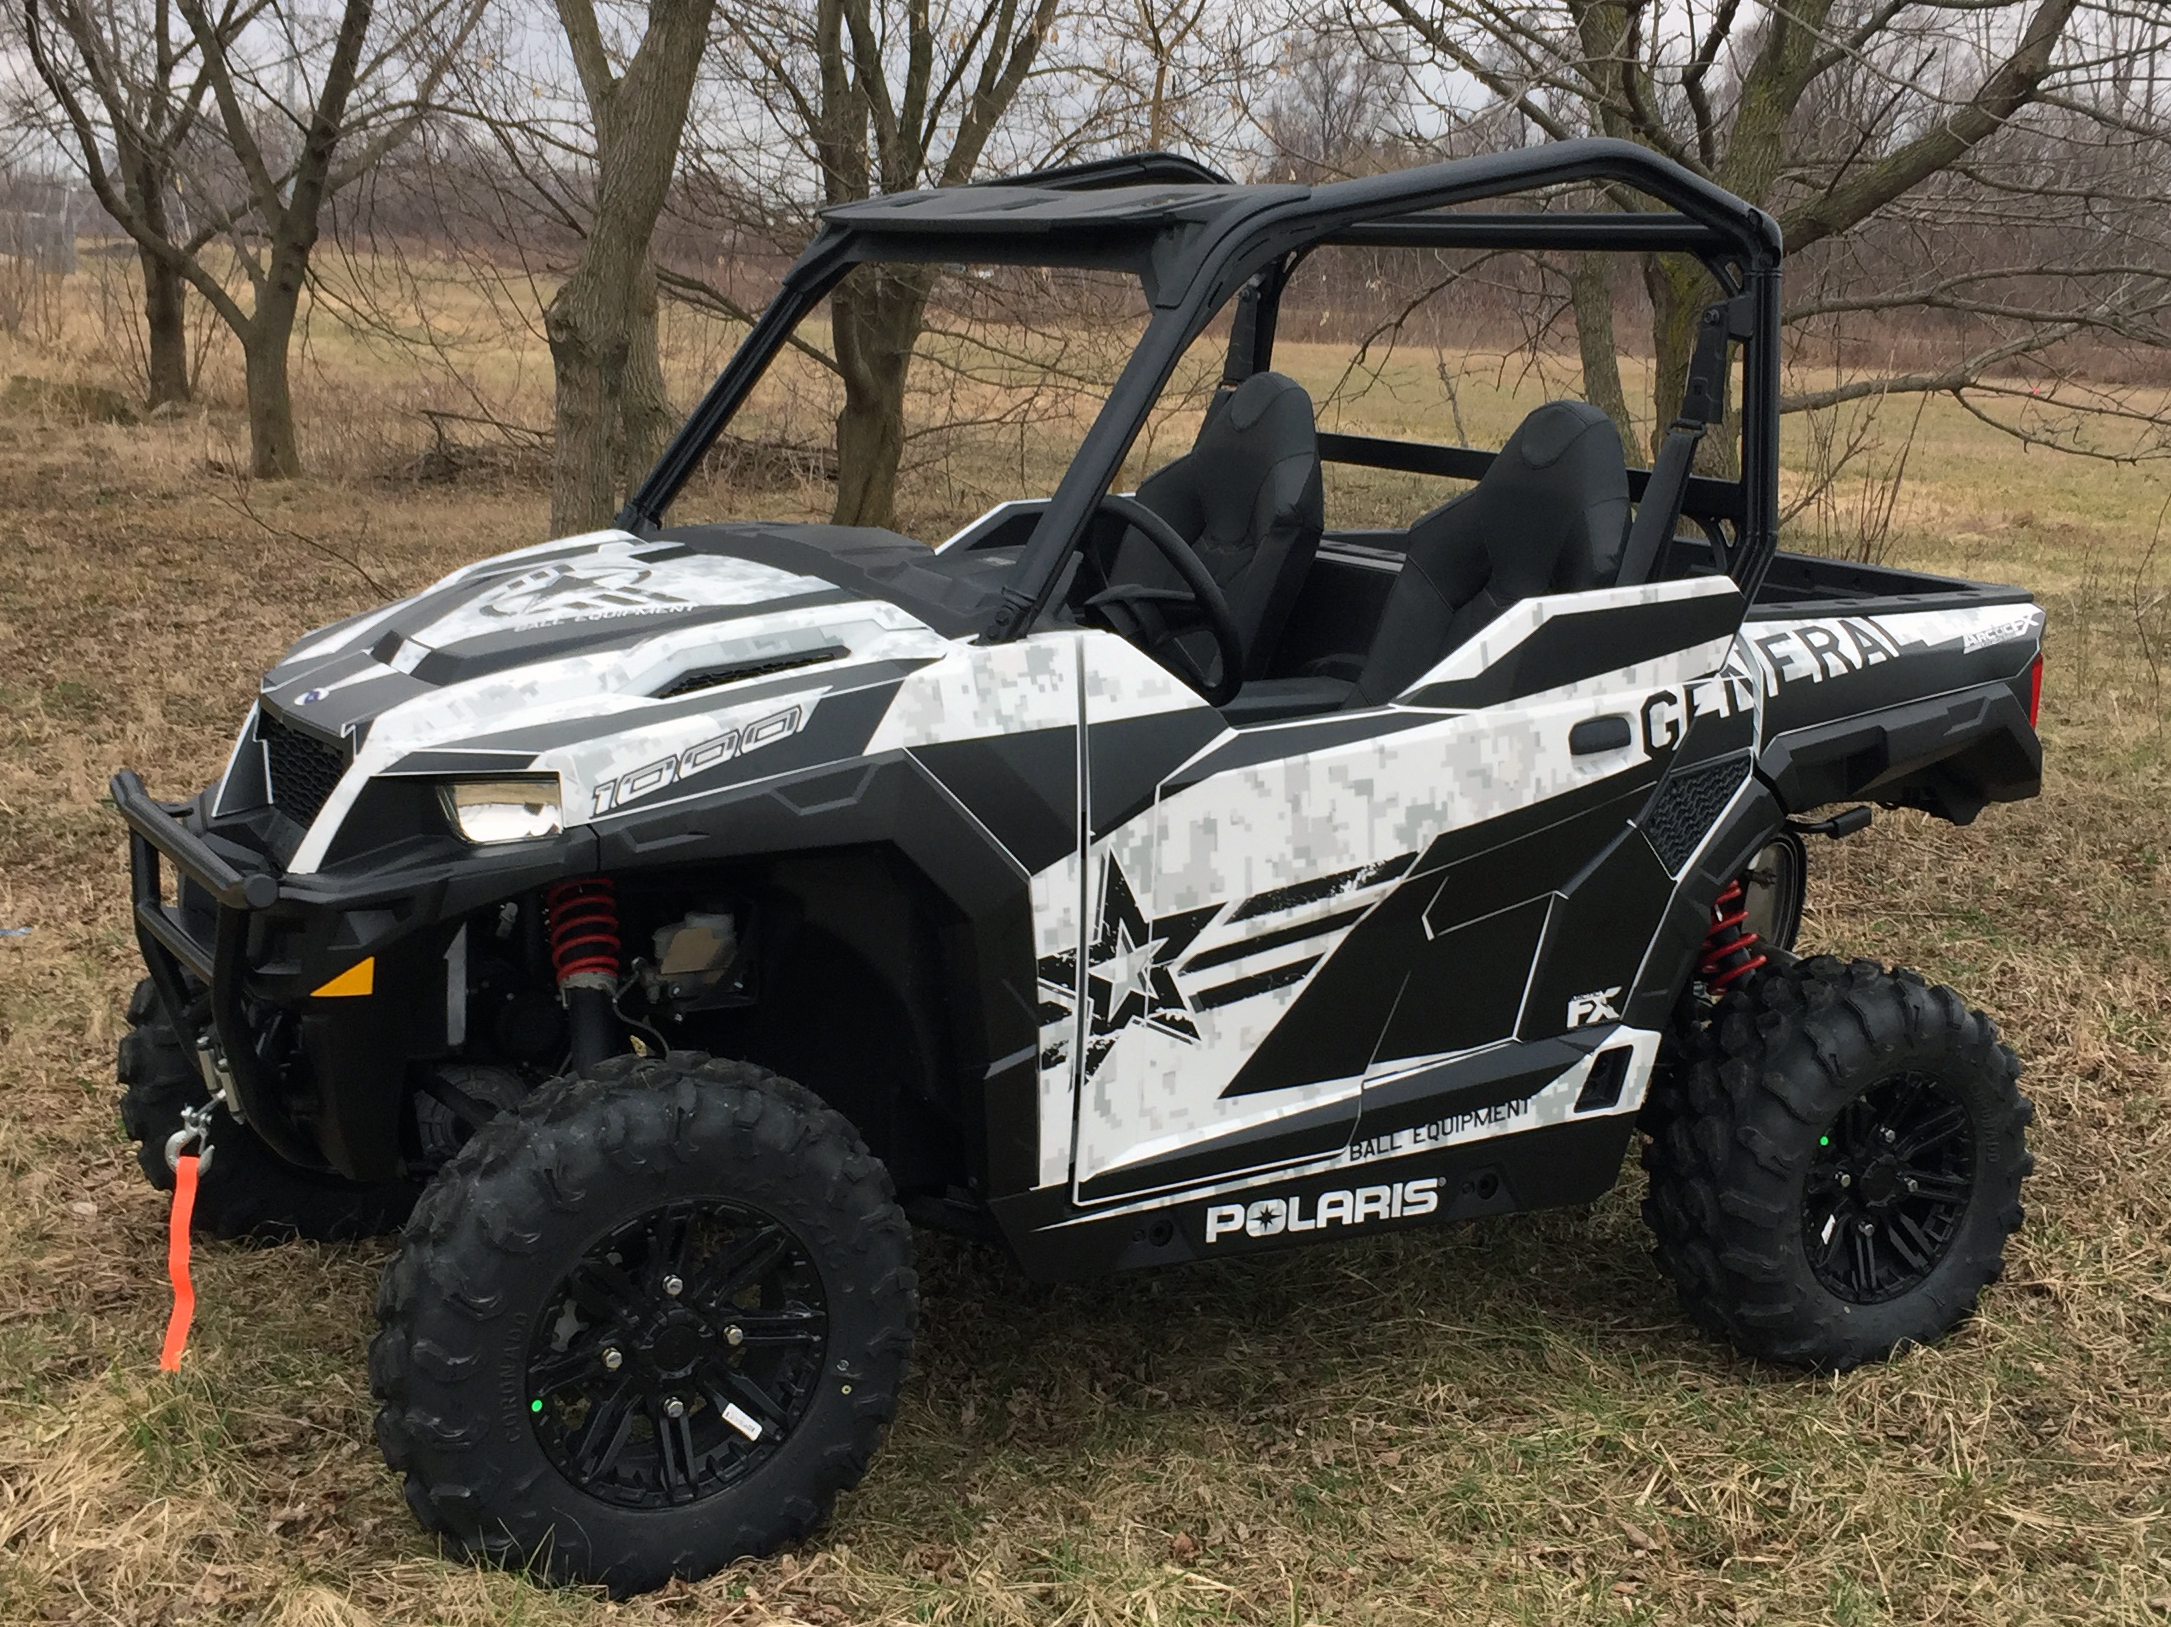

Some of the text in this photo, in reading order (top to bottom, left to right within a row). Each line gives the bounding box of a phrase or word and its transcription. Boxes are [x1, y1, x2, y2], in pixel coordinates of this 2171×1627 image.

[589, 704, 804, 819] 1000
[1350, 1098, 1532, 1162] BALL EQUIPMENT
[1206, 1177, 1439, 1244] POLARIS
